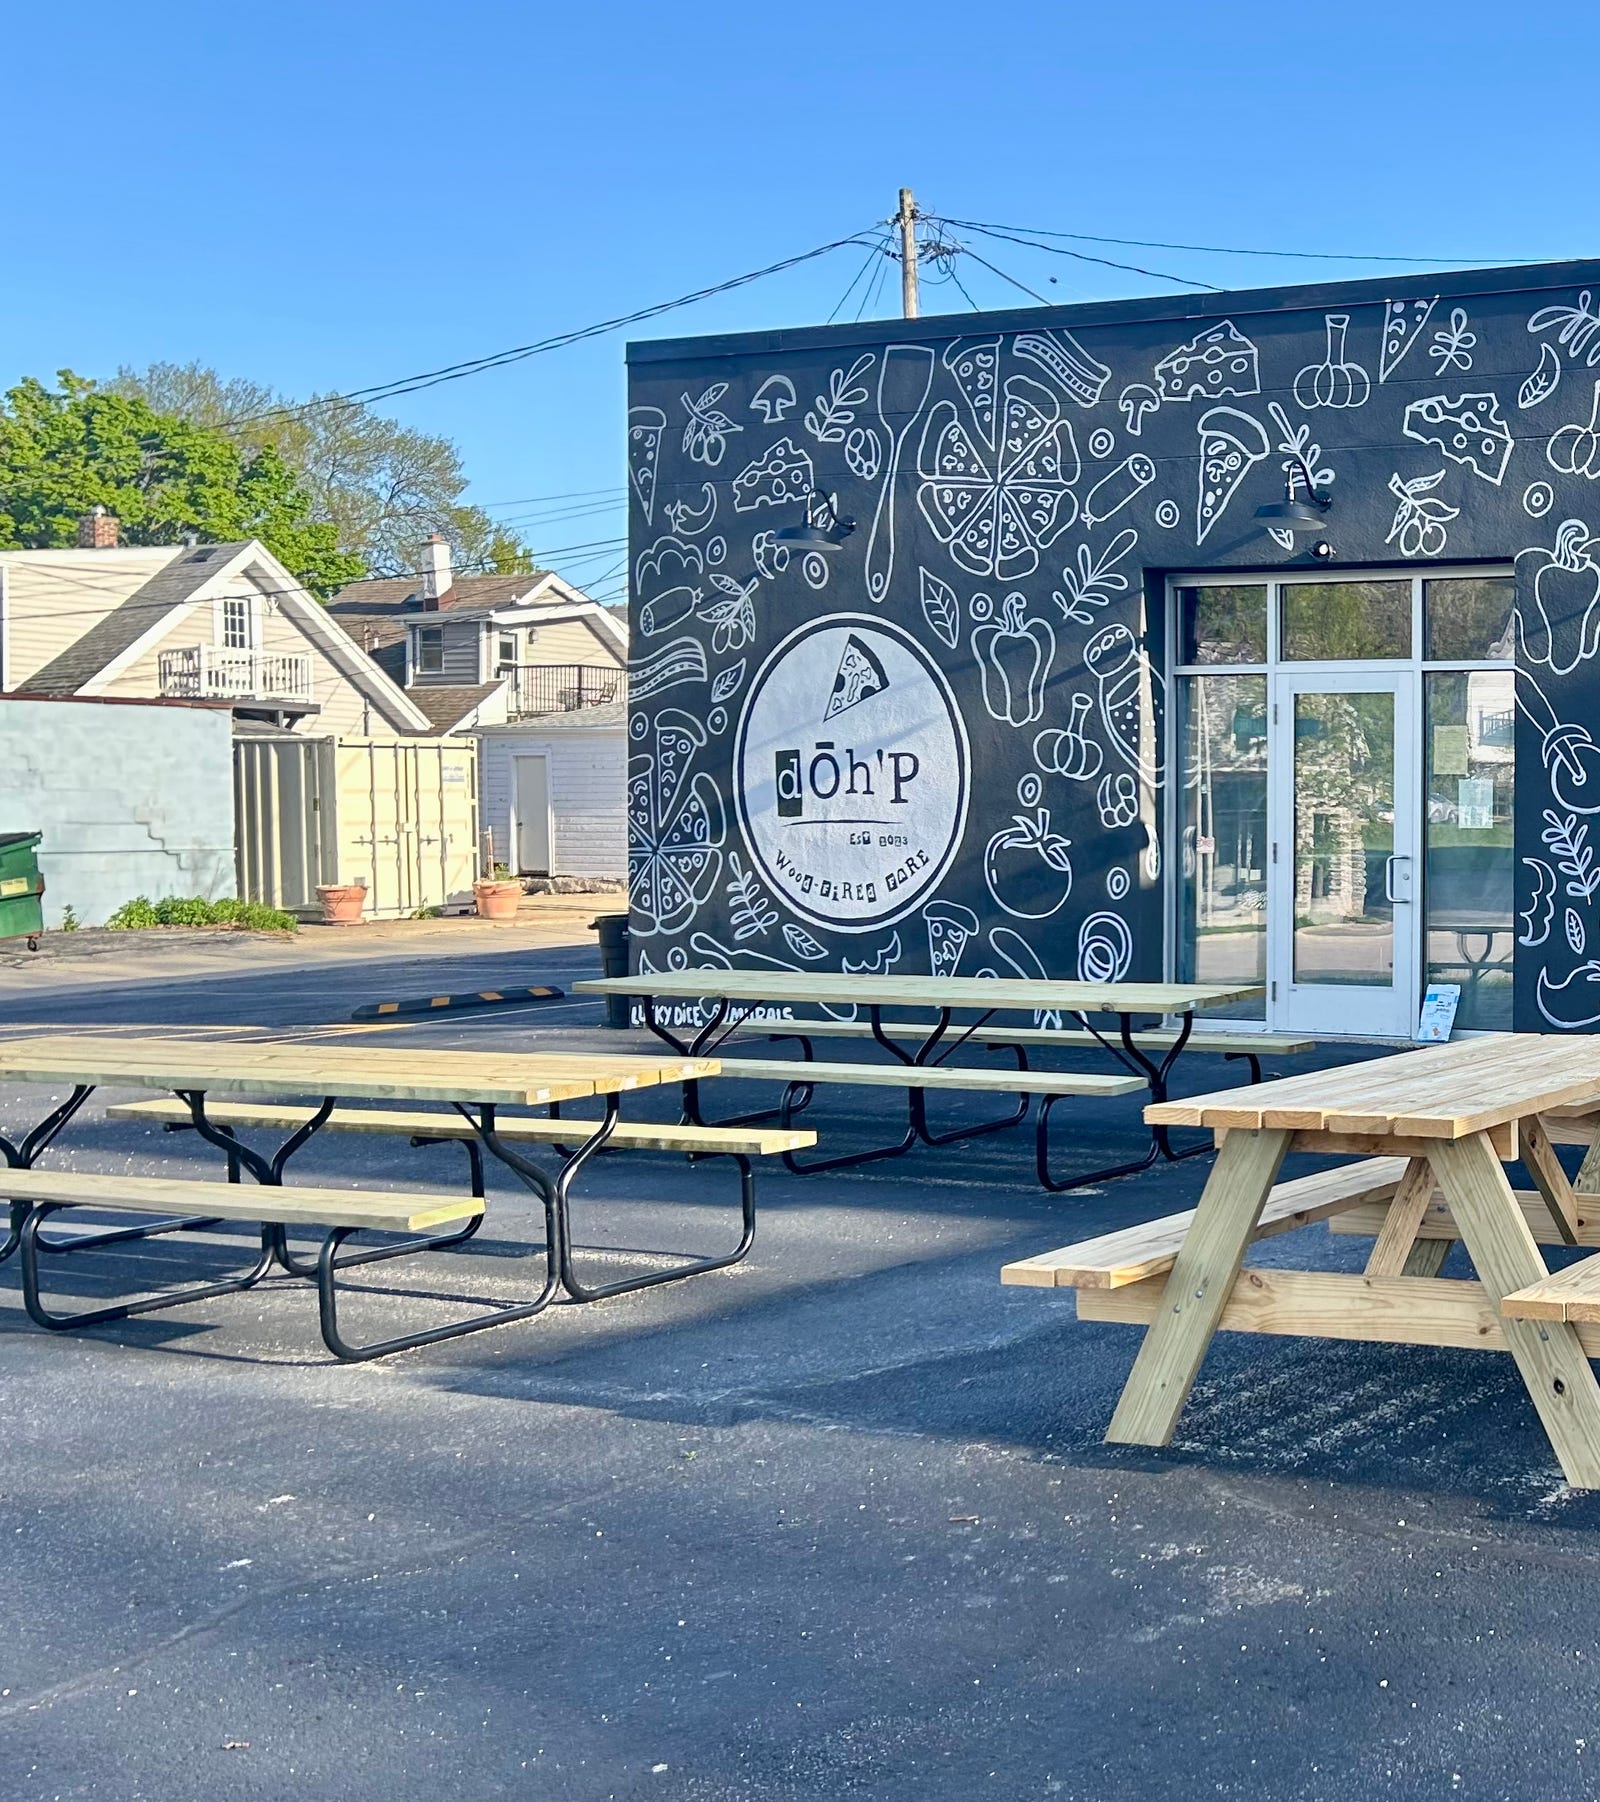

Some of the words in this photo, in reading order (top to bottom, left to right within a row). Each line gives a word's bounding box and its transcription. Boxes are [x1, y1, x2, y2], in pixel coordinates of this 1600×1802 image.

[879, 835, 908, 847] 2023
[885, 849, 930, 892] FARE
[631, 1004, 672, 1026] LUKY
